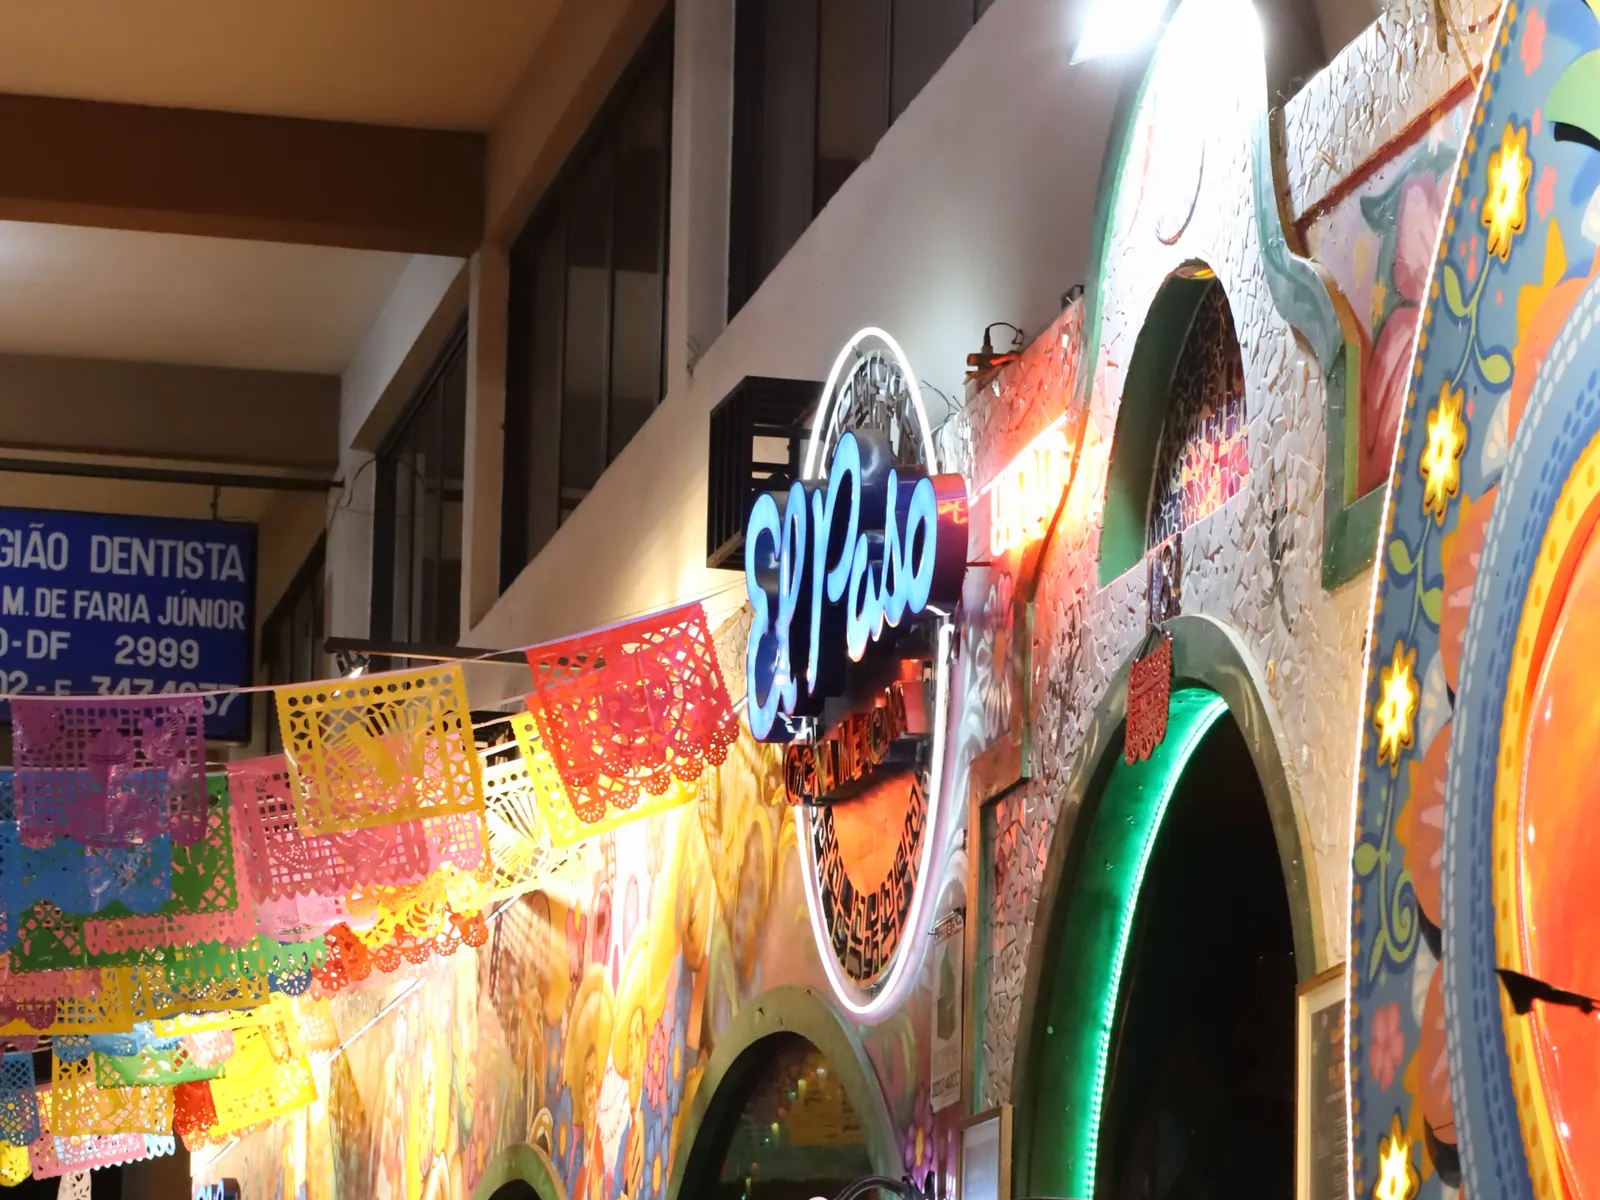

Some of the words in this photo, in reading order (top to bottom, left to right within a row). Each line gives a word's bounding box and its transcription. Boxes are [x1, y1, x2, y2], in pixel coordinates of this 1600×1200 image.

[90, 534, 246, 583] DENTISTA
[3, 585, 30, 617] M.
[35, 587, 67, 619] DE
[74, 590, 151, 624] FARIA
[157, 589, 247, 631] JÚNIOR
[745, 480, 807, 741] El
[808, 430, 938, 695] Paso
[115, 635, 200, 670] 2999
